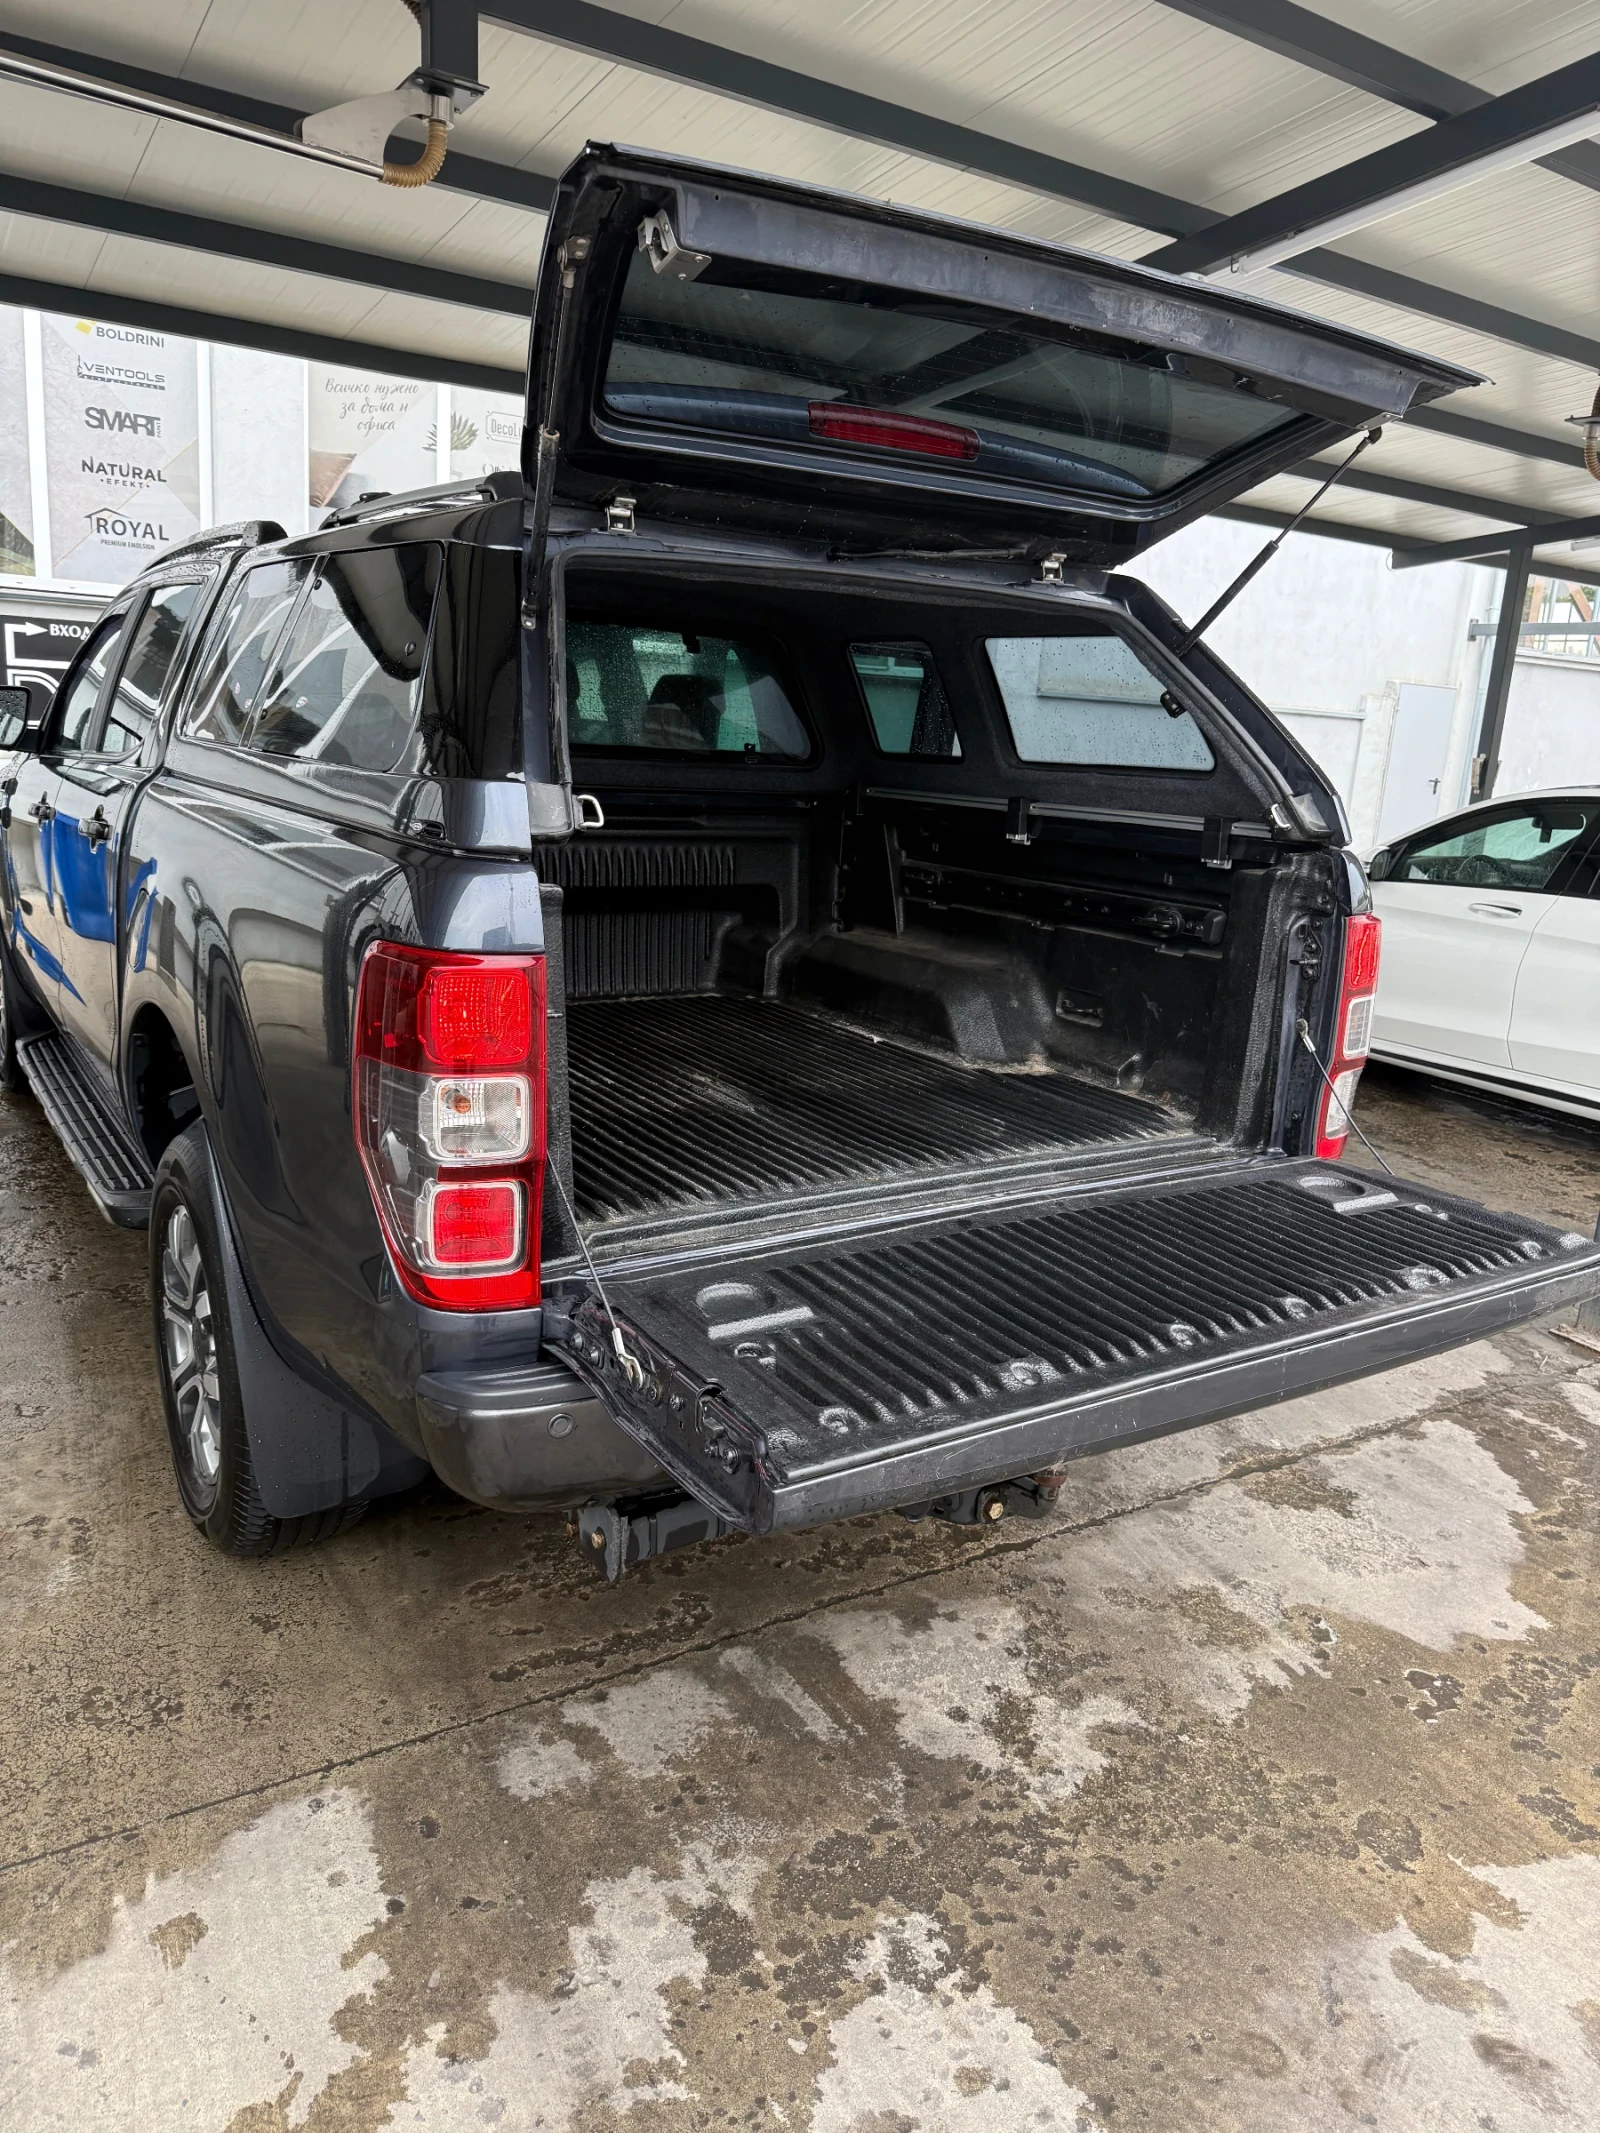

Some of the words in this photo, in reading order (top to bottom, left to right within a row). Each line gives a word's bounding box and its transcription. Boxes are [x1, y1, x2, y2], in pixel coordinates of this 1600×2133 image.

[96, 326, 165, 348] BOLDRINI
[83, 362, 165, 383] VENTOOLS
[325, 378, 370, 393] Всичко
[375, 384, 419, 400] нужно
[339, 401, 355, 419] за
[360, 396, 395, 414] дома
[400, 402, 409, 412] и
[84, 406, 161, 437] SMART
[357, 416, 395, 437] офиса
[81, 455, 167, 483] NATURAL
[106, 478, 144, 489] EFEKT
[96, 517, 170, 541] ROYAL
[100, 538, 127, 548] PREMIUM
[127, 541, 156, 550] EMULSION
